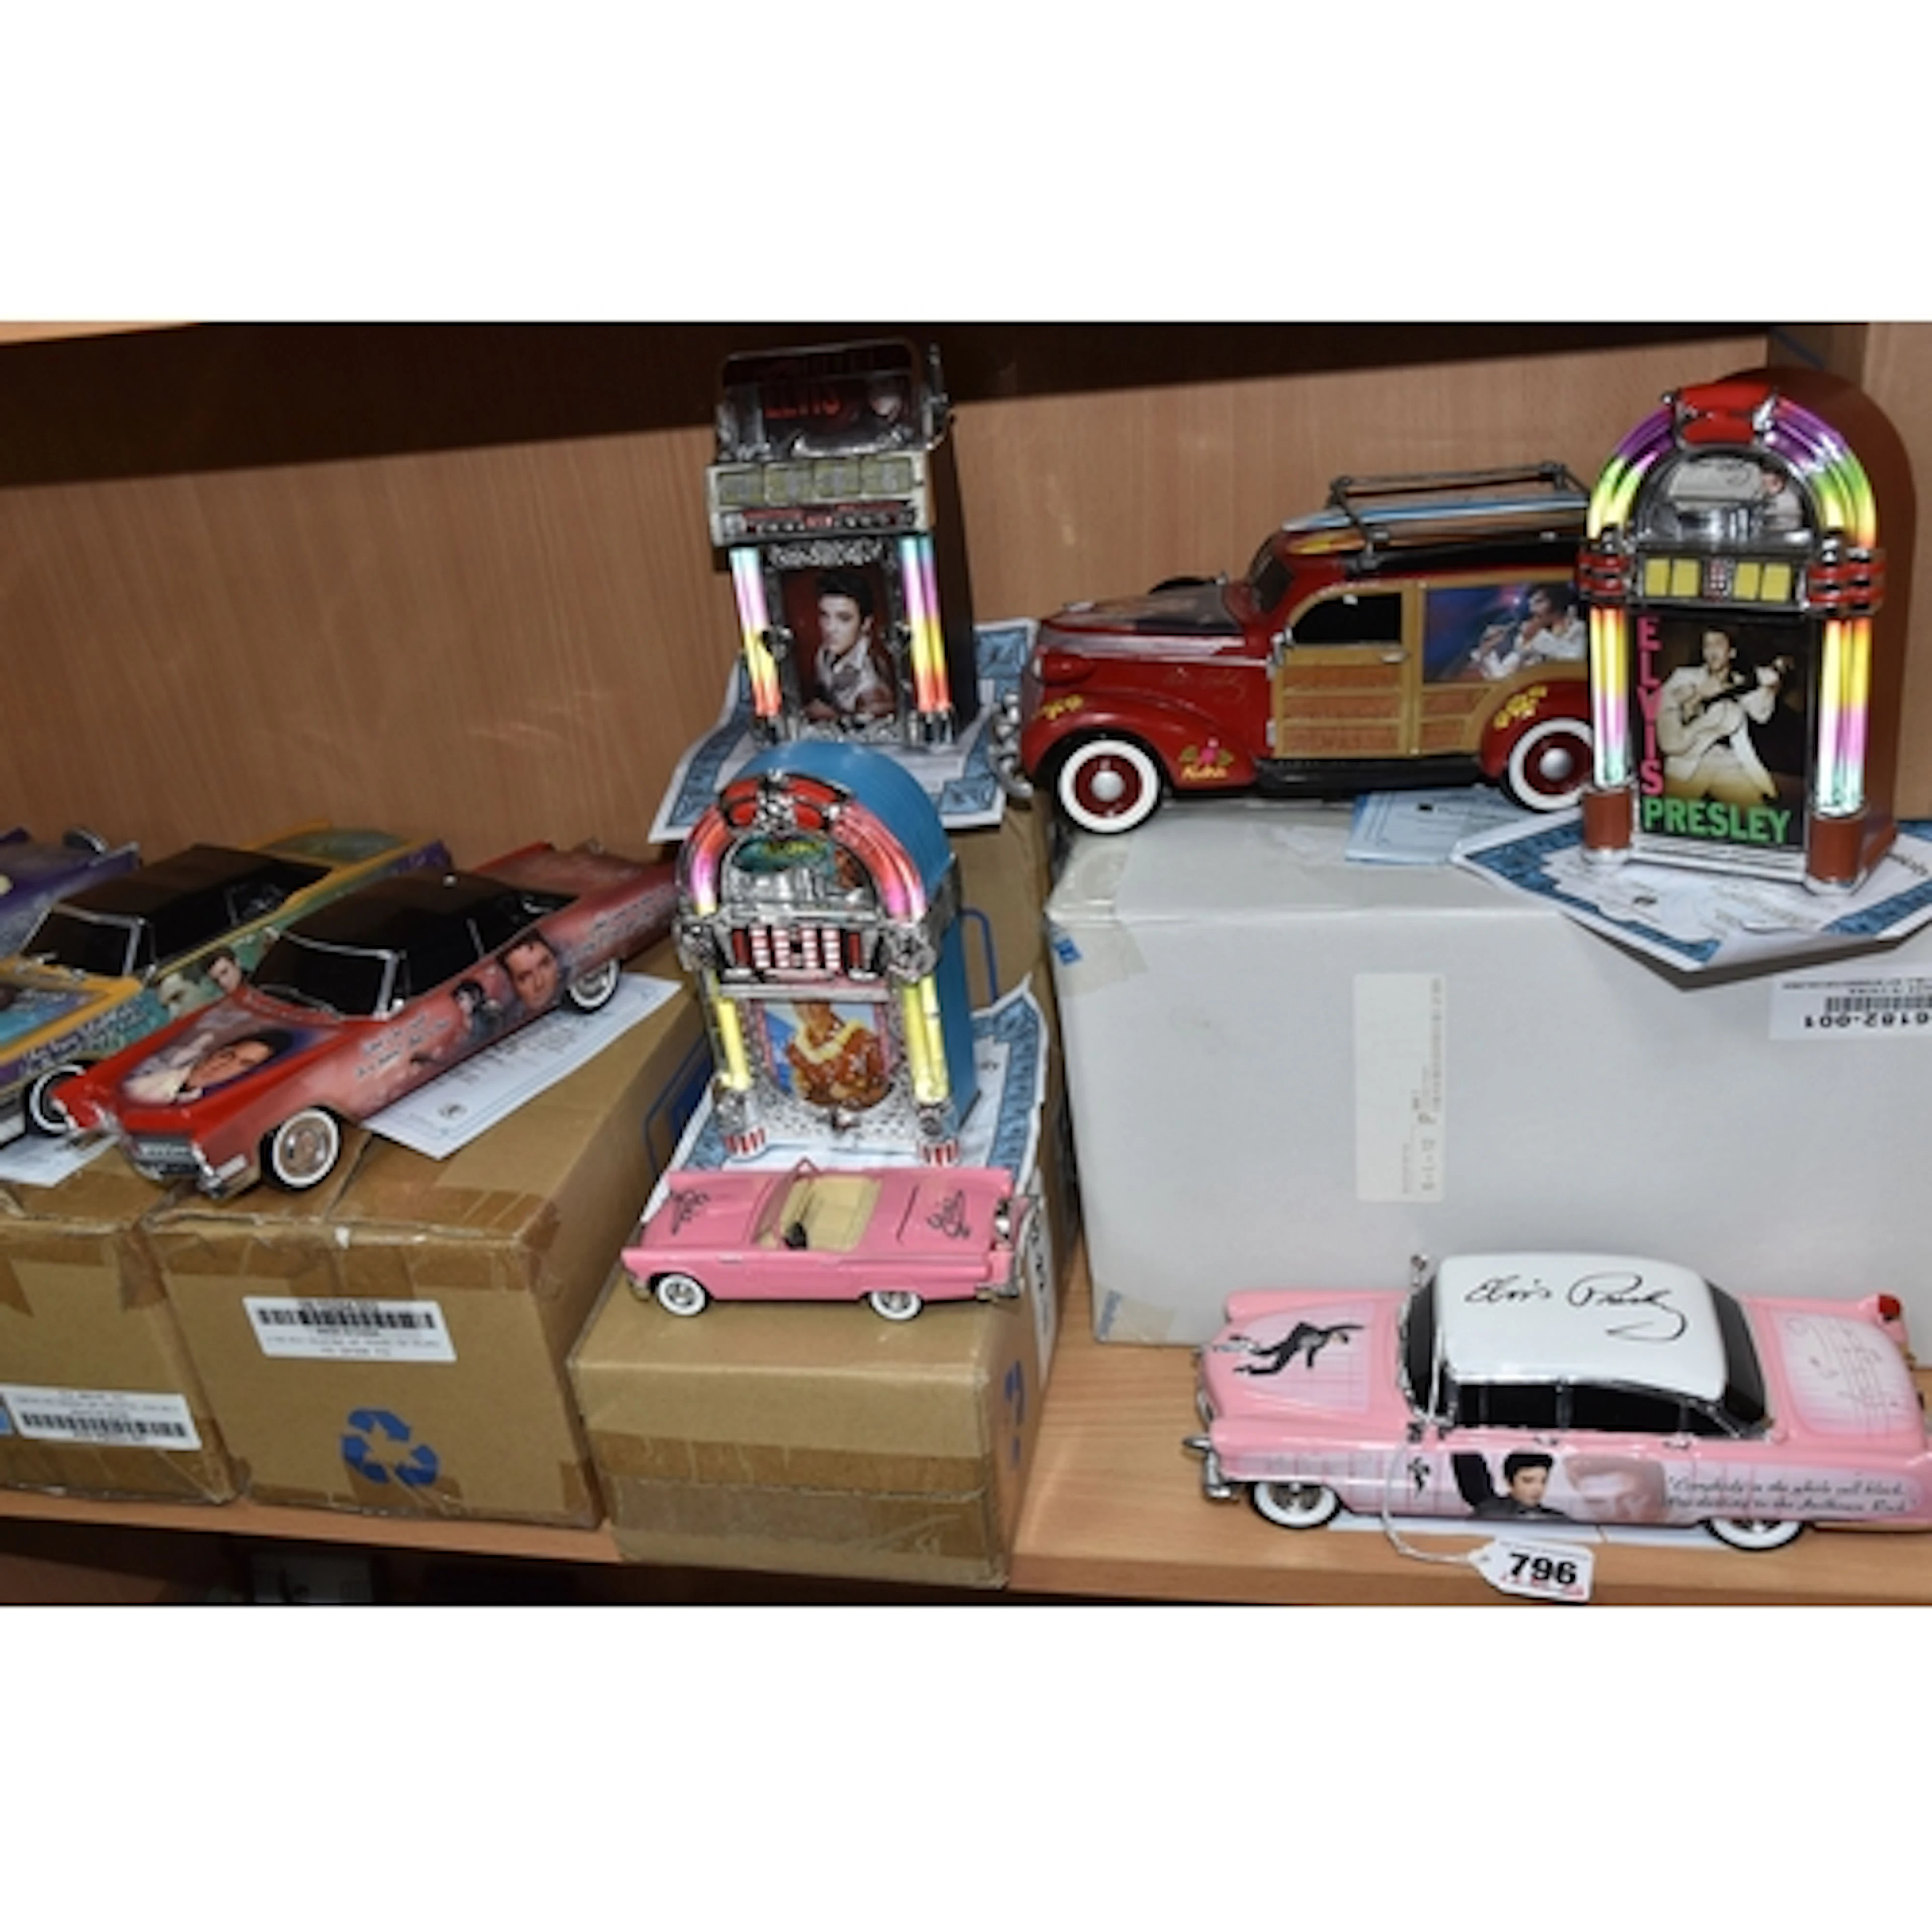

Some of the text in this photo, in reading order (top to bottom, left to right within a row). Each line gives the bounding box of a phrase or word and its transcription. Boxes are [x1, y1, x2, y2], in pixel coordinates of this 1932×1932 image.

[1637, 616, 1663, 796] ELVIS
[1641, 796, 1792, 844] PRESLEY
[1509, 1552, 1577, 1584] 796
